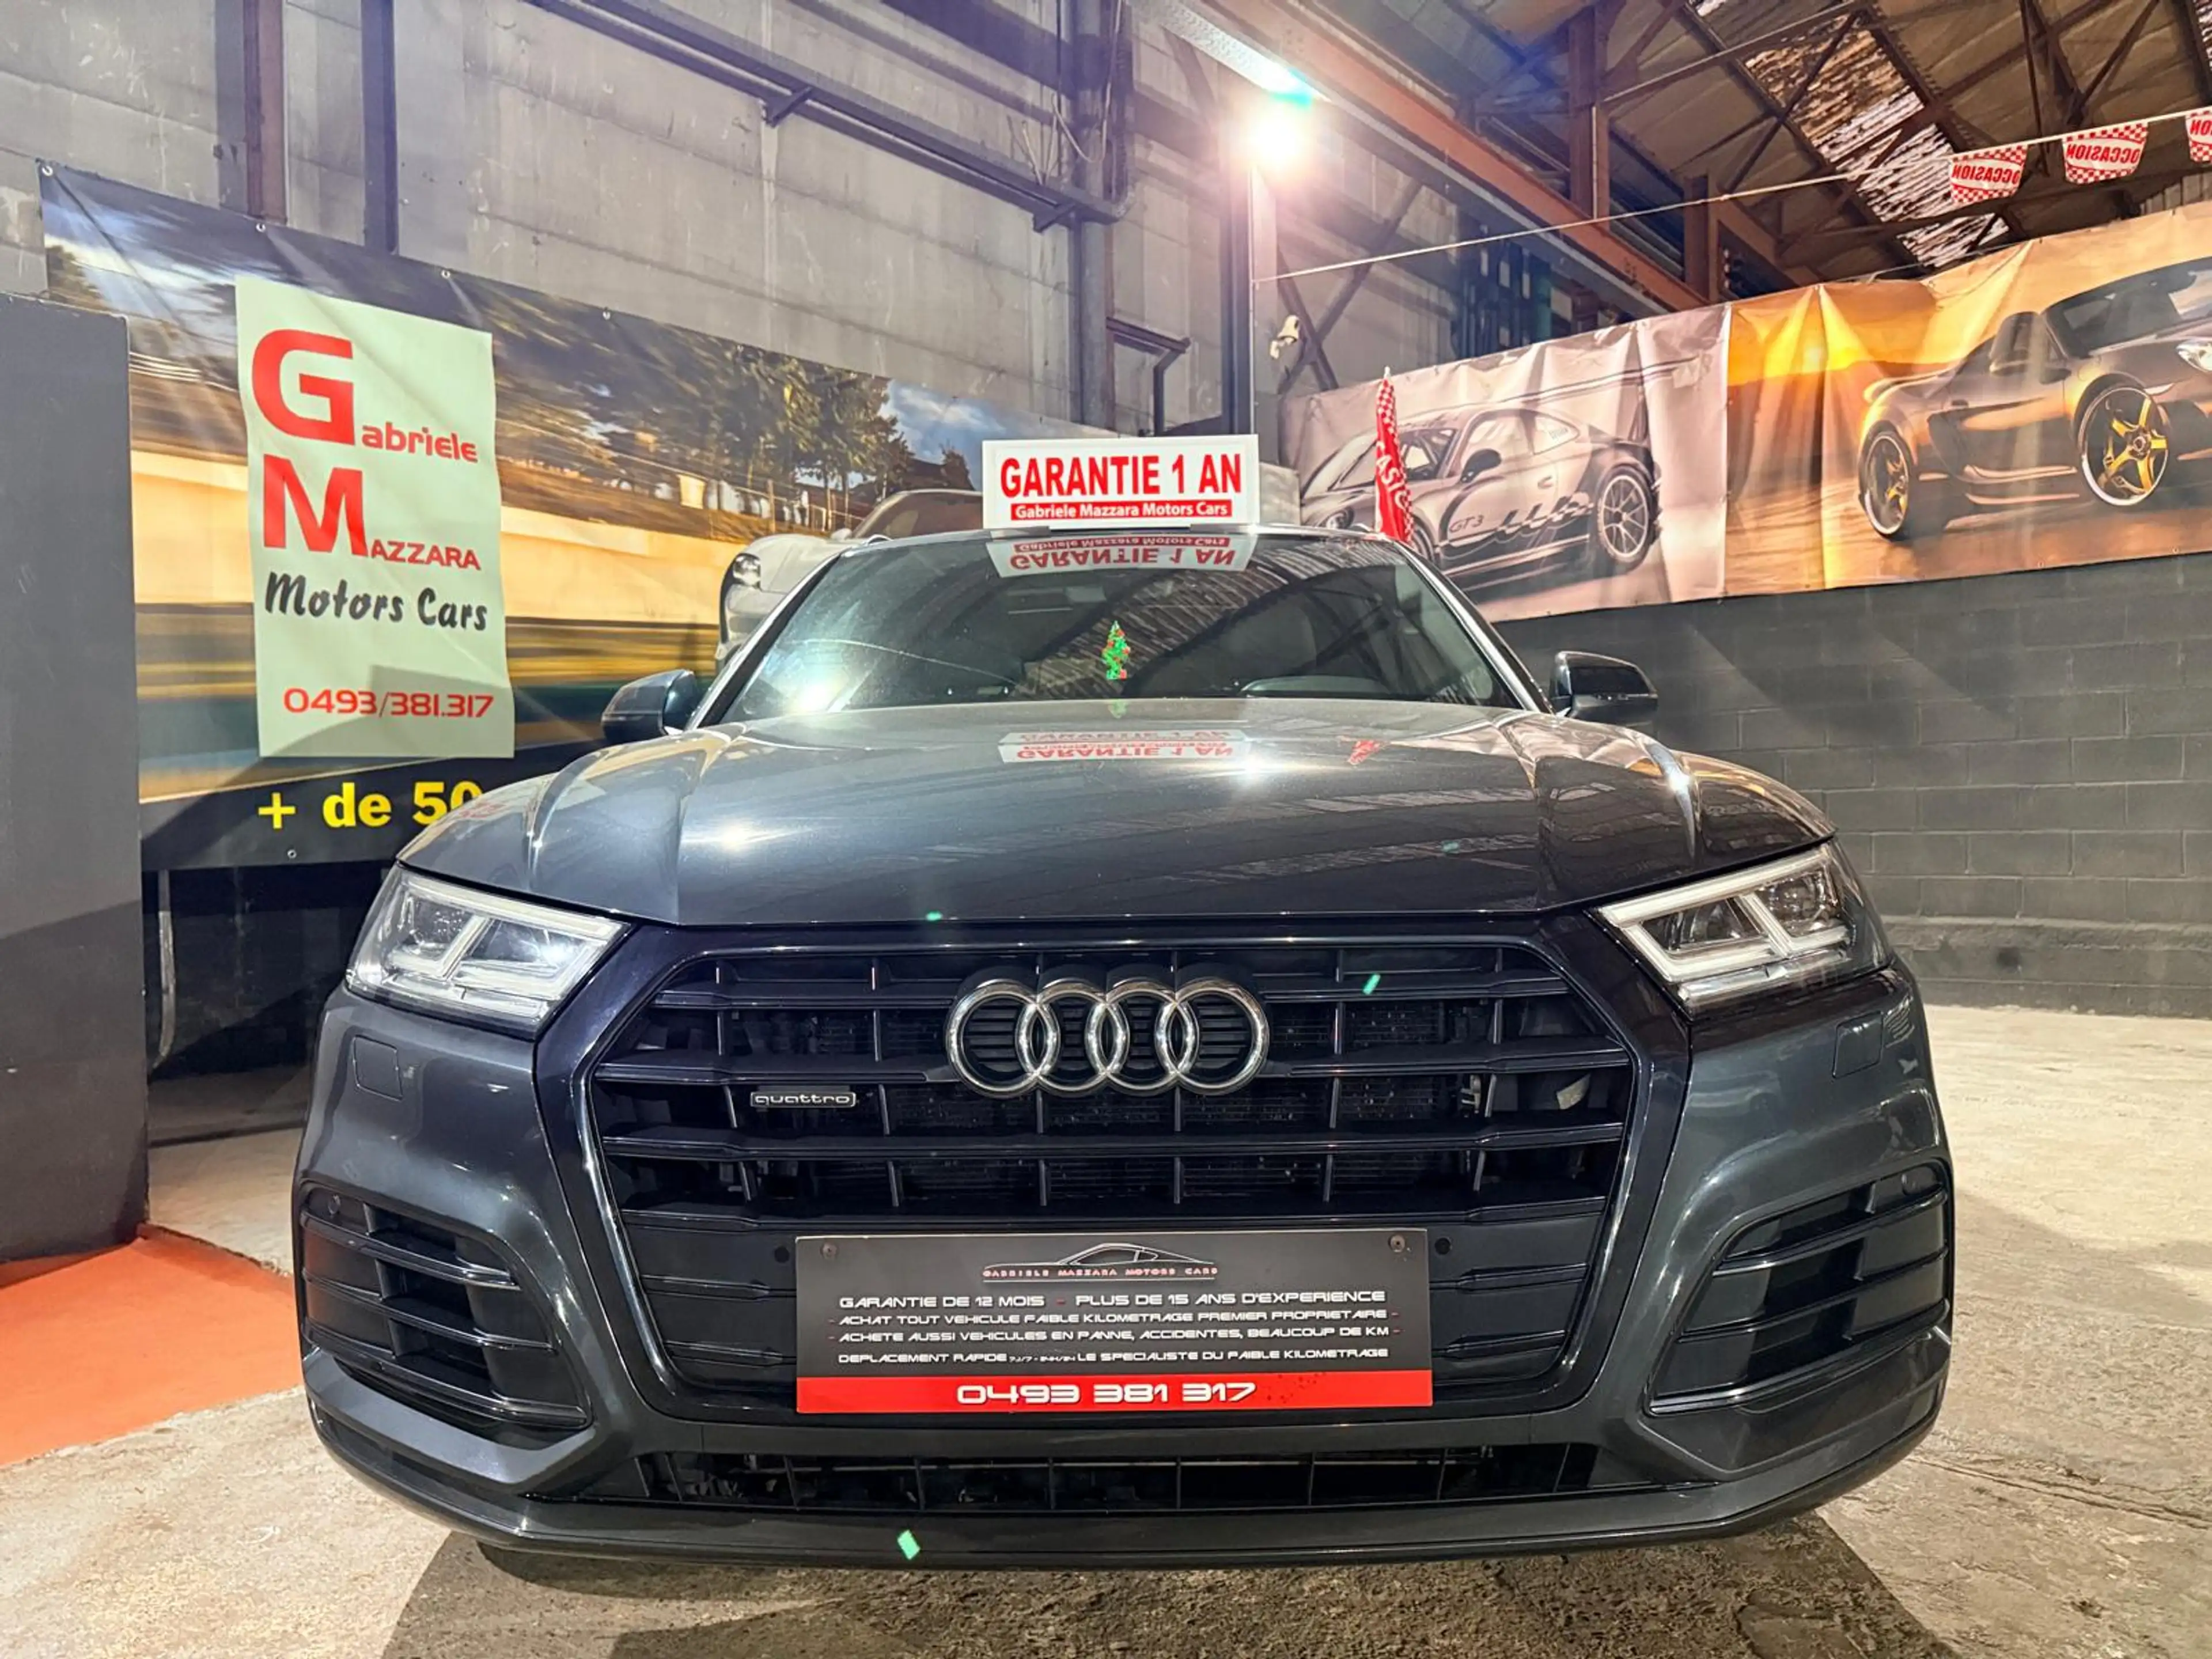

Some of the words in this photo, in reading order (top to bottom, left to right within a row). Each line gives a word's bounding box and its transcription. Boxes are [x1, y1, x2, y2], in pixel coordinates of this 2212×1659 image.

[1001, 456, 1160, 498] GARANTIE
[1172, 454, 1184, 494] 1
[1199, 454, 1241, 494] AN
[1016, 504, 1076, 518] Gabriele
[1080, 503, 1139, 517] Mazzara
[1143, 502, 1192, 516] Motors
[1196, 502, 1228, 515] Cars
[265, 571, 403, 622] Motors
[418, 587, 487, 631] Cars
[283, 688, 494, 718] 0493/381.317
[323, 782, 391, 828] de
[755, 1094, 850, 1106] quattro
[839, 1297, 937, 1308] GARANTIE
[942, 1297, 969, 1308] DE
[975, 1297, 993, 1307] 12
[999, 1296, 1045, 1306] MOIS
[1075, 1295, 1130, 1306] PLUS
[1135, 1294, 1162, 1305] DE
[1168, 1294, 1189, 1305] 15
[1195, 1293, 1236, 1304] ANS
[1241, 1291, 1385, 1304] D'EXPERIENCE
[839, 1316, 892, 1325] ACHAT
[897, 1315, 940, 1324] TOUT
[944, 1315, 1020, 1324] VEHICULE
[1024, 1314, 1079, 1324] FAIBLE
[1083, 1313, 1194, 1323] KILOMETRAGE
[1198, 1311, 1267, 1321] PREMIER
[1271, 1309, 1387, 1320] PROPRIETAIRE
[839, 1332, 904, 1342] ACHETE
[908, 1332, 956, 1342] AUSSI
[960, 1331, 1047, 1341] VEHICULES
[1051, 1331, 1074, 1340] EN
[1077, 1330, 1135, 1342] PANNE,
[1139, 1328, 1244, 1339] ACCIDENTES,
[1247, 1327, 1335, 1338] BEAUCOUP
[1339, 1327, 1362, 1336] DE
[1365, 1327, 1389, 1336] KM
[838, 1354, 949, 1363] DEPLACEMENT
[953, 1353, 1007, 1363] RAPIDE
[1077, 1353, 1096, 1361] LE
[1100, 1351, 1198, 1362] SPECIALISTE
[1202, 1351, 1224, 1360] DU
[1227, 1350, 1280, 1360] FAIBLE
[1284, 1349, 1389, 1359] KILOMETRAGE
[957, 1384, 1081, 1404] 0493
[1093, 1383, 1168, 1403] 381
[1182, 1382, 1256, 1403] 317
